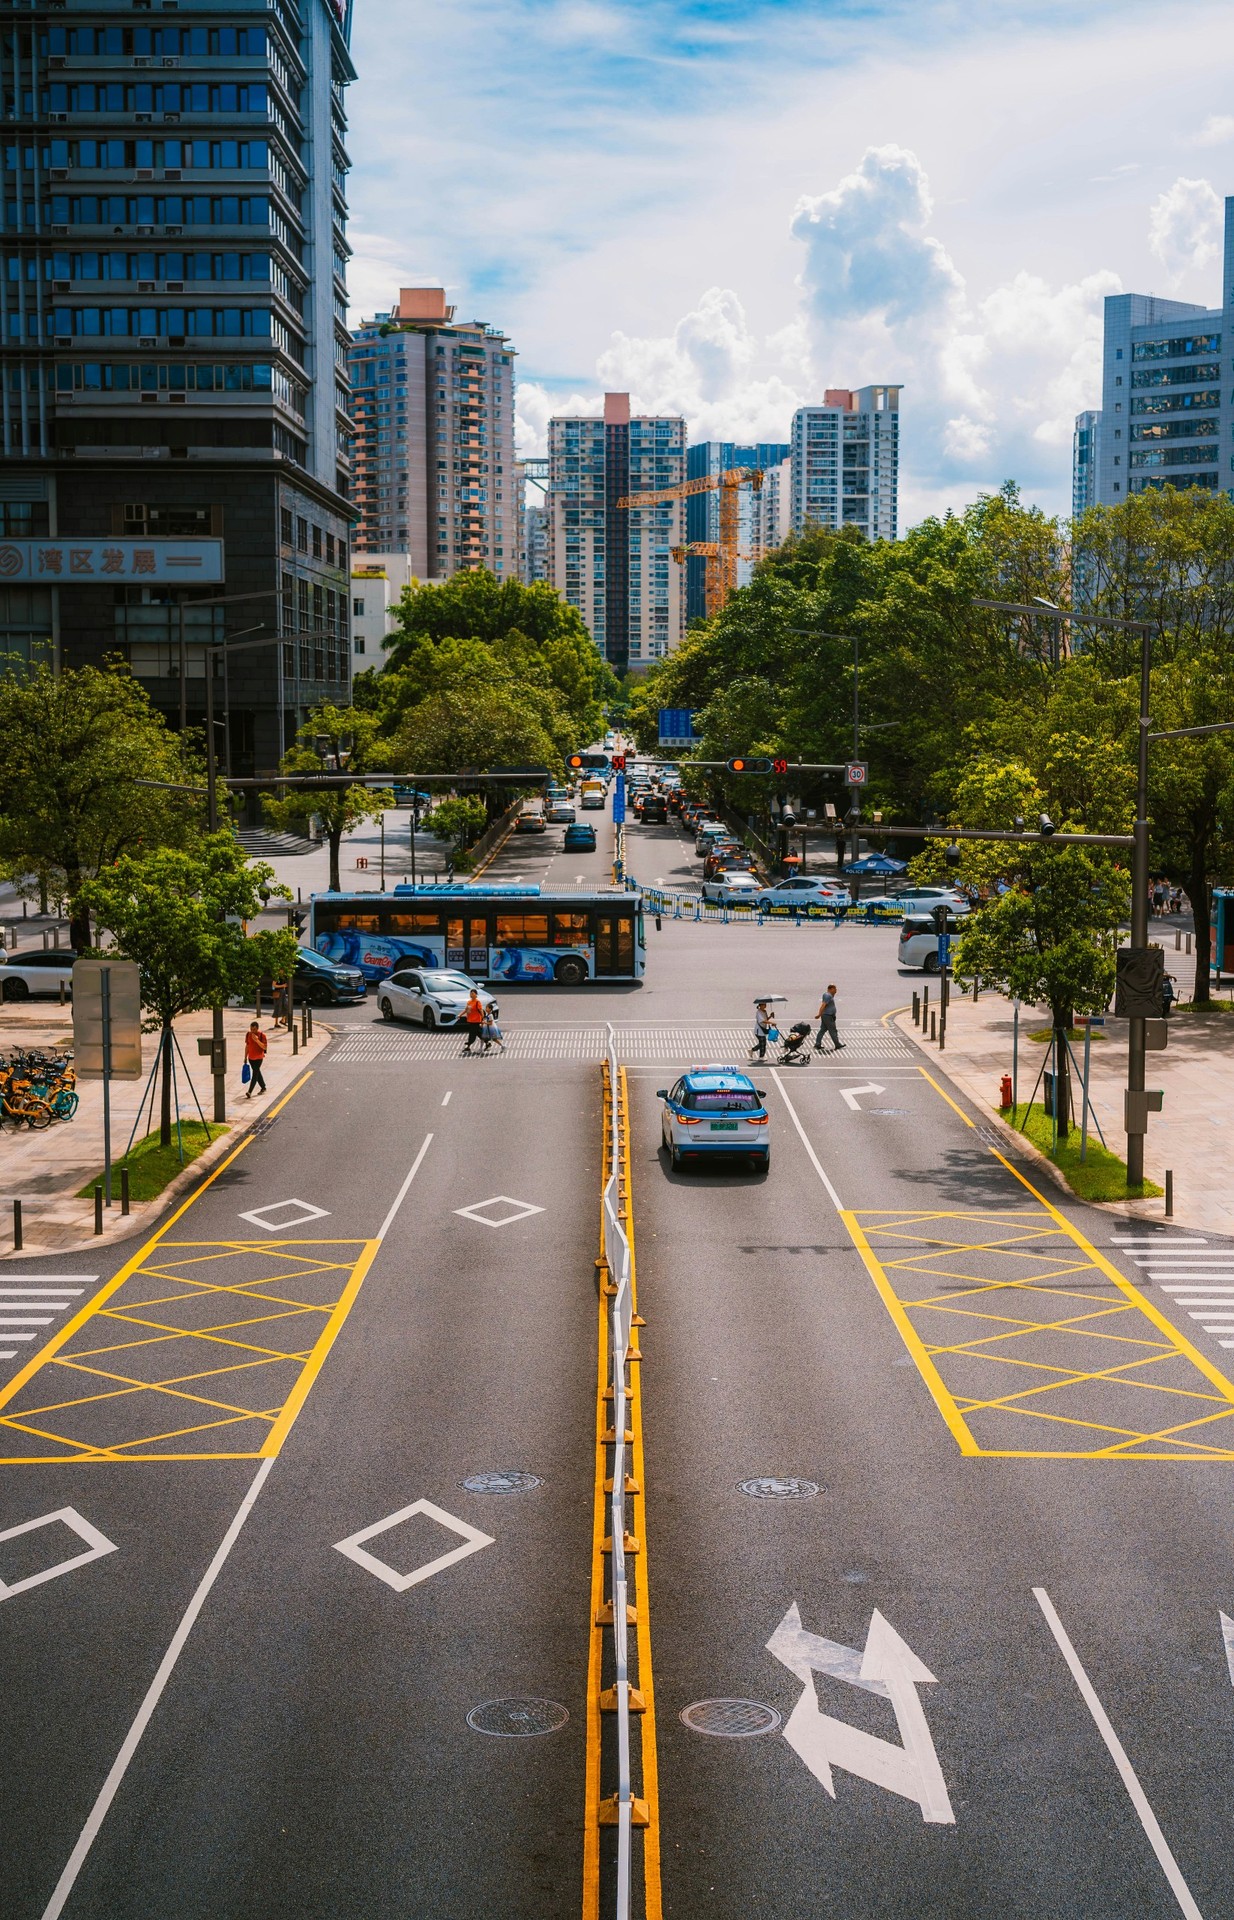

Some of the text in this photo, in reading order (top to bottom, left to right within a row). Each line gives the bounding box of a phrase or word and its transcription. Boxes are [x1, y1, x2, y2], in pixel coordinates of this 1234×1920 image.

[38, 547, 157, 574] 湾区发展
[612, 757, 625, 769] 59
[774, 760, 787, 773] 59
[852, 770, 861, 779] 30
